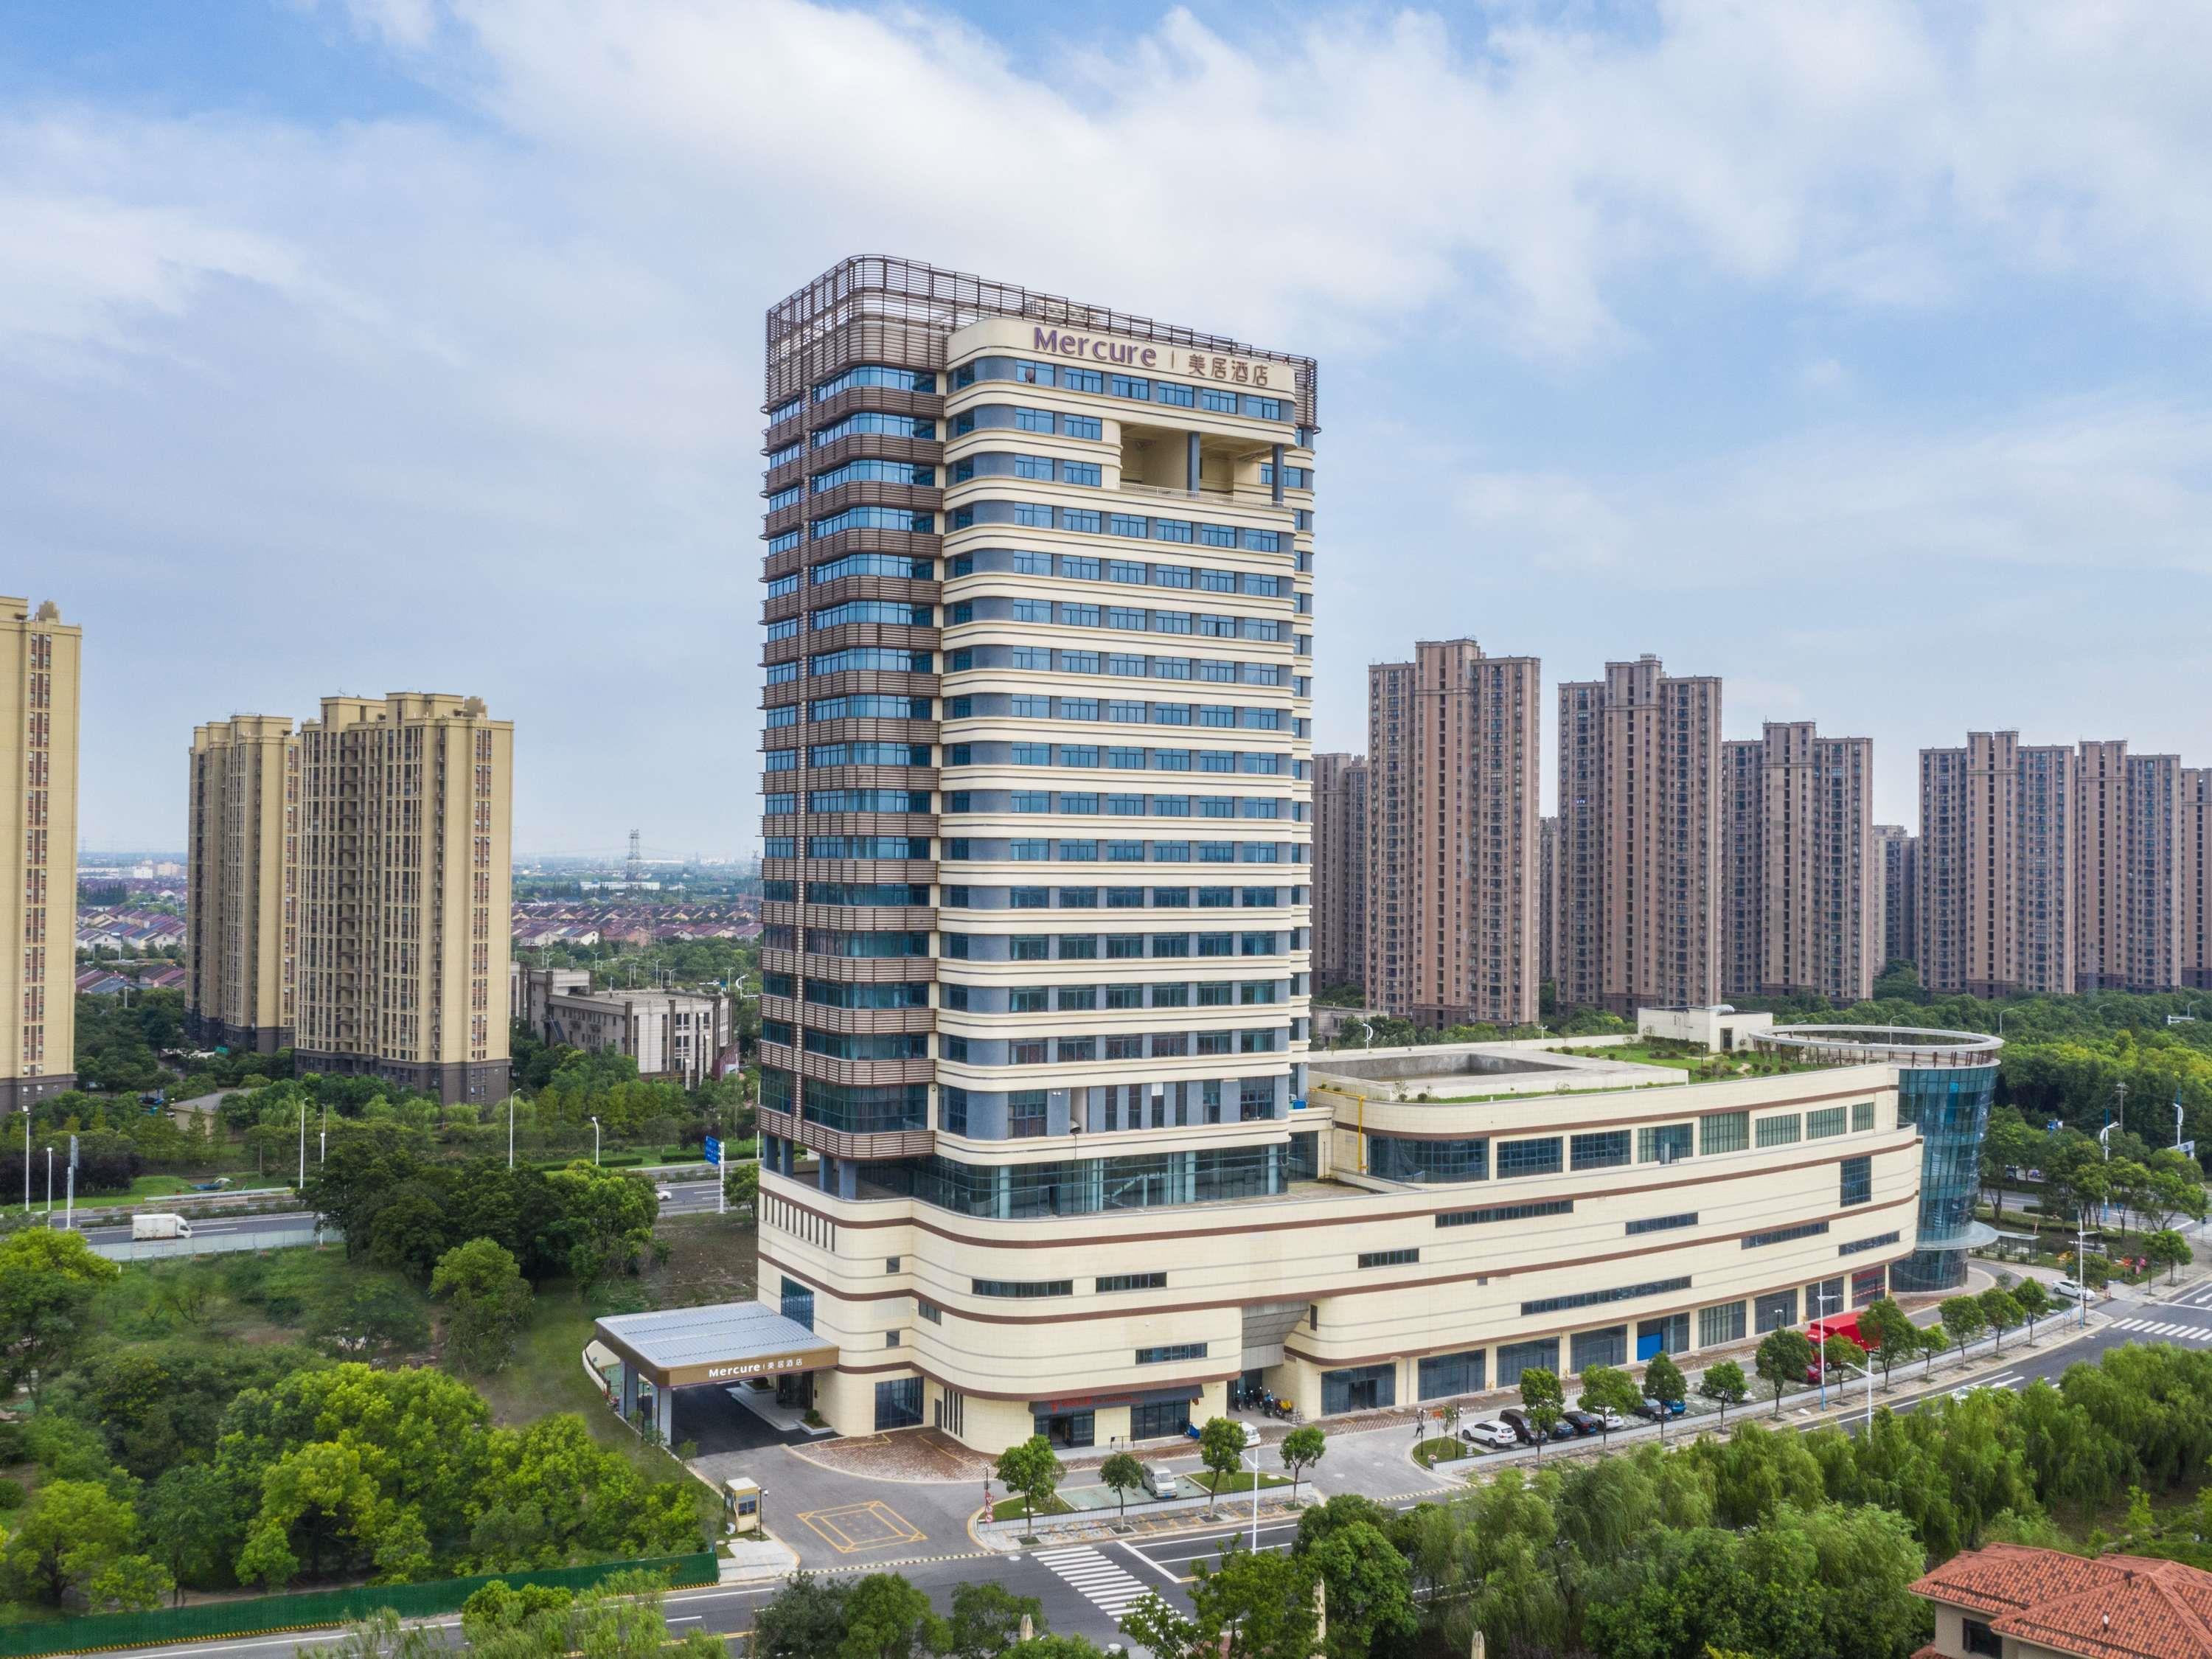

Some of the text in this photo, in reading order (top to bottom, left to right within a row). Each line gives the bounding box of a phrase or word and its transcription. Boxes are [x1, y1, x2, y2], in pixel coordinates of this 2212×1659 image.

[1034, 327, 1156, 367] Mercure
[1189, 354, 1267, 386] 美居酒店
[709, 1363, 760, 1377] Mercure
